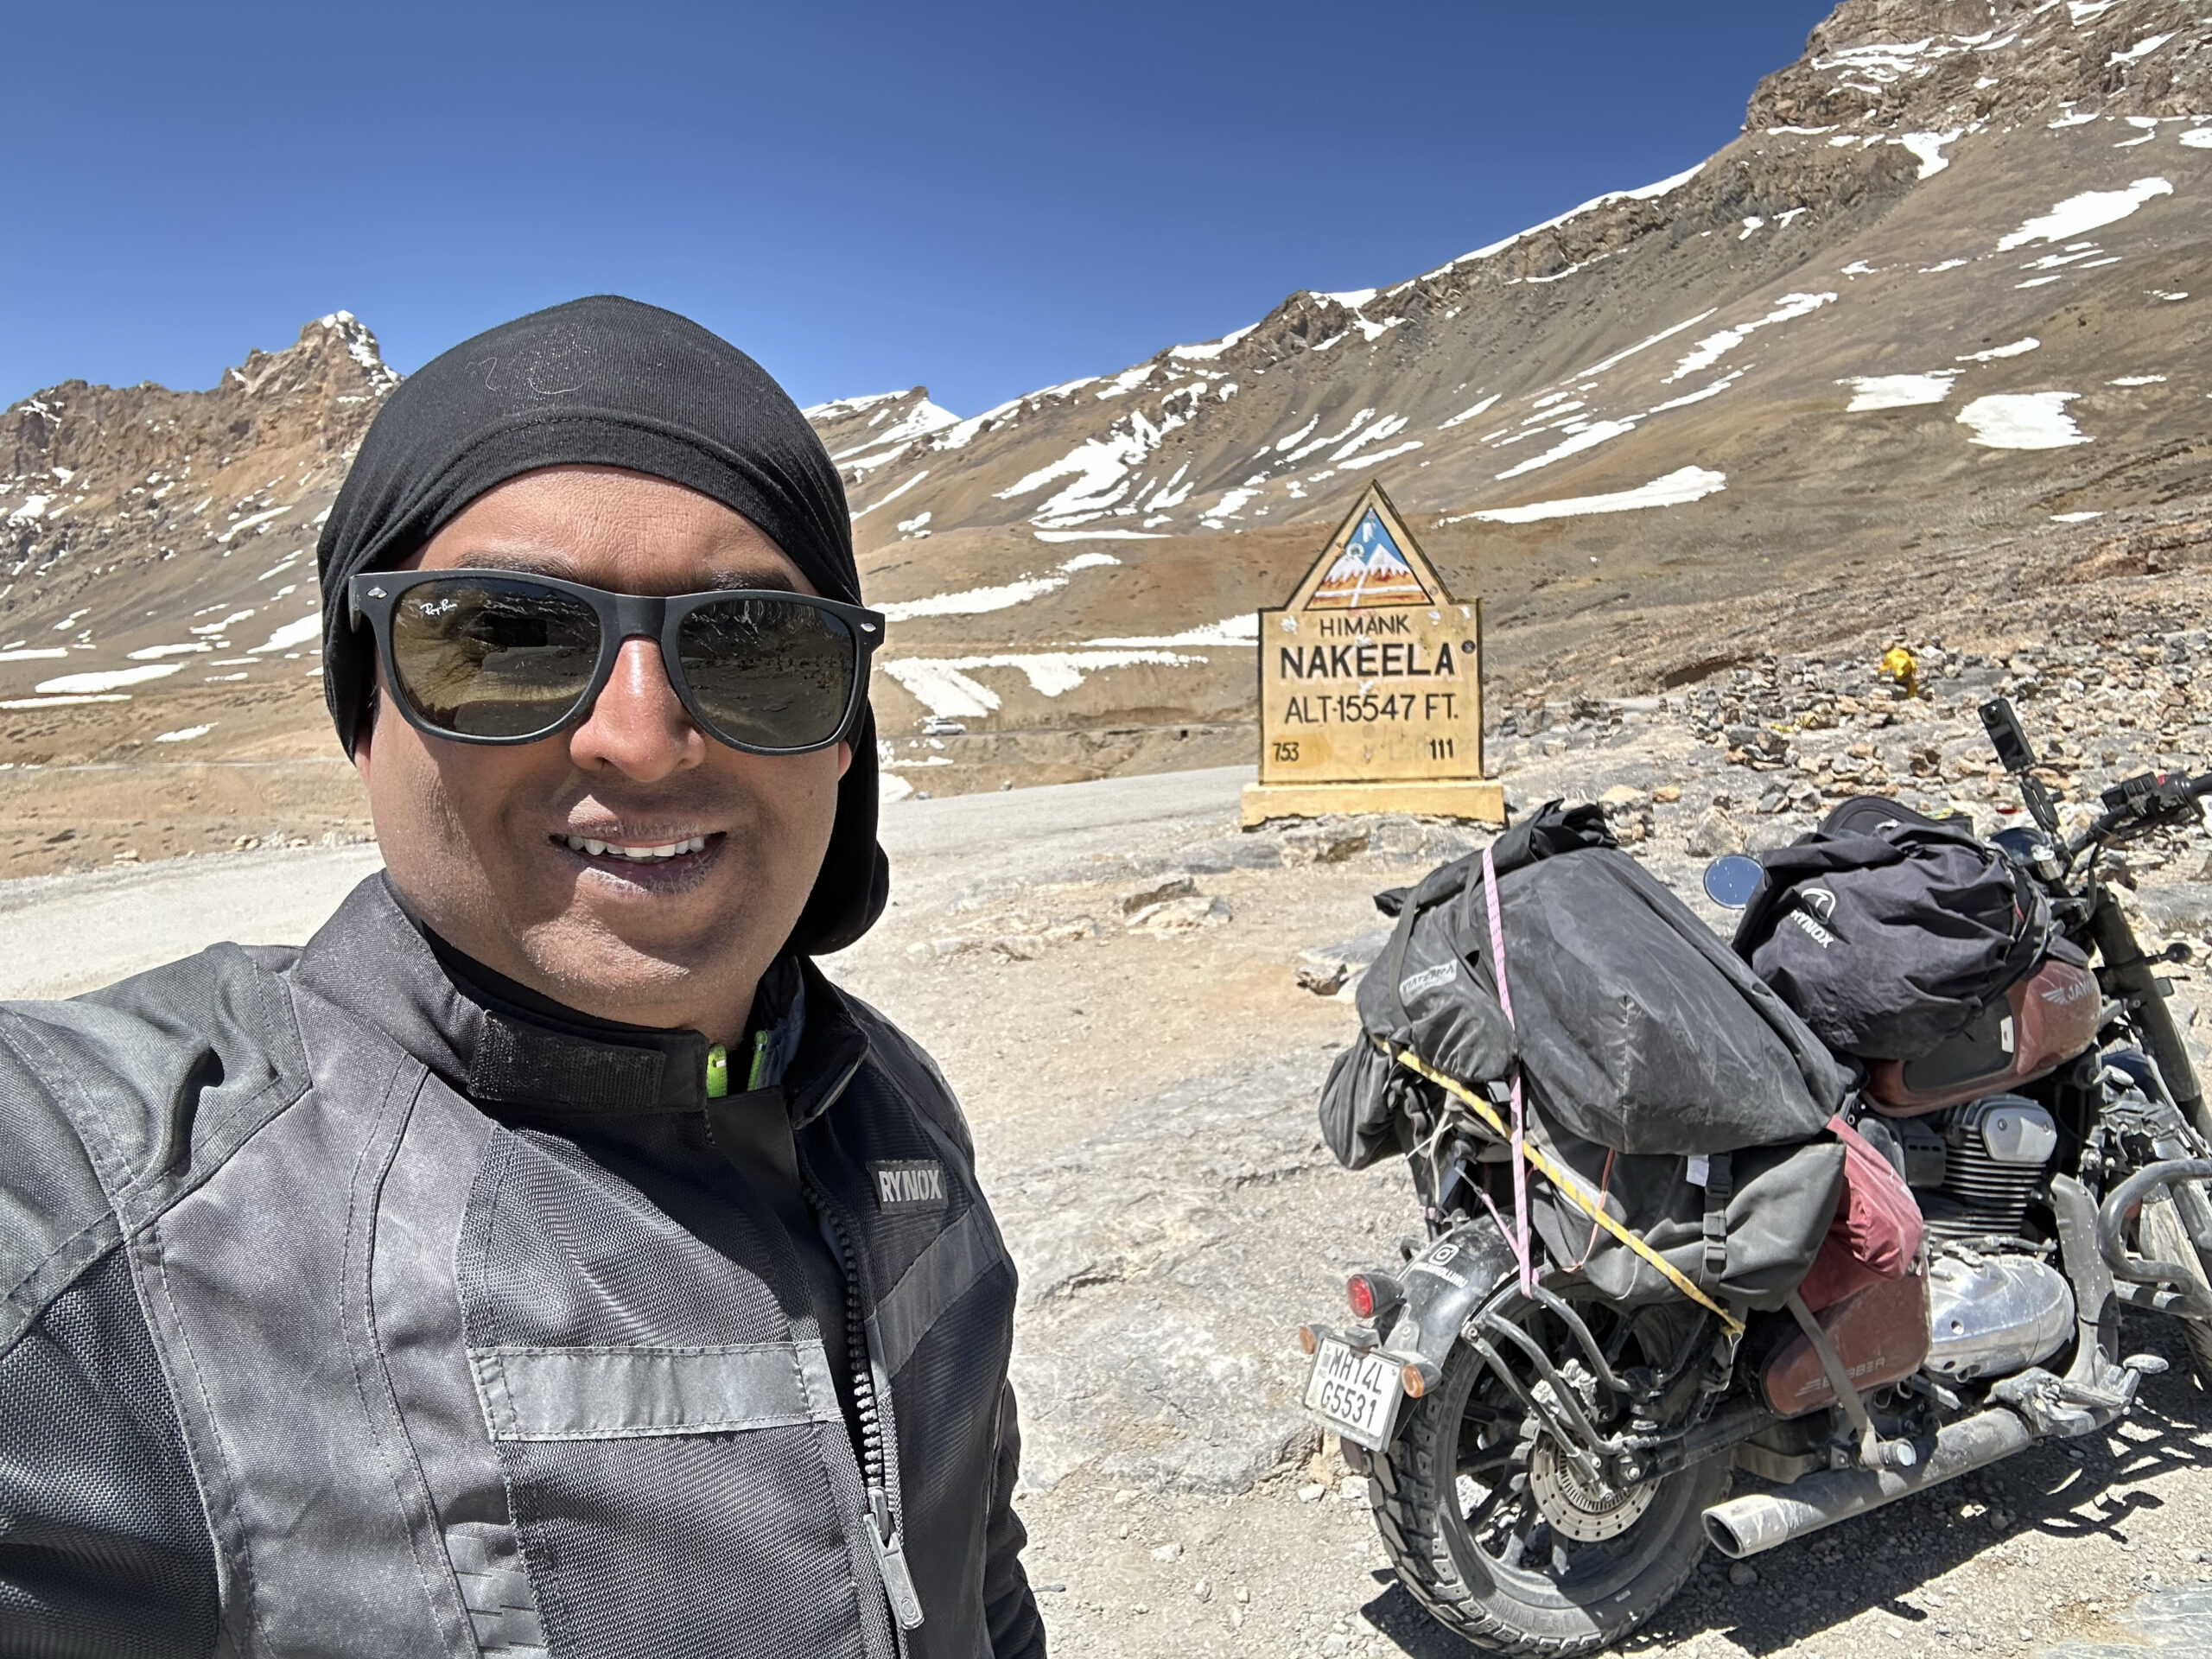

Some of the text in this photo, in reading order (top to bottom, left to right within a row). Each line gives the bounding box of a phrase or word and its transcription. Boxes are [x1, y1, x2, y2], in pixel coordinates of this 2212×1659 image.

[419, 598, 458, 615] Ray-Ban
[1319, 614, 1411, 638] HIMANK
[1281, 642, 1455, 679] NAKEELA
[1425, 693, 1459, 721] FT.
[1272, 741, 1300, 762] 753
[1430, 739, 1453, 760] 111
[2068, 980, 2094, 1001] JAW
[878, 1169, 943, 1202] RYNOX
[1328, 1347, 1383, 1395] MH14L
[1320, 1380, 1377, 1428] G5531
